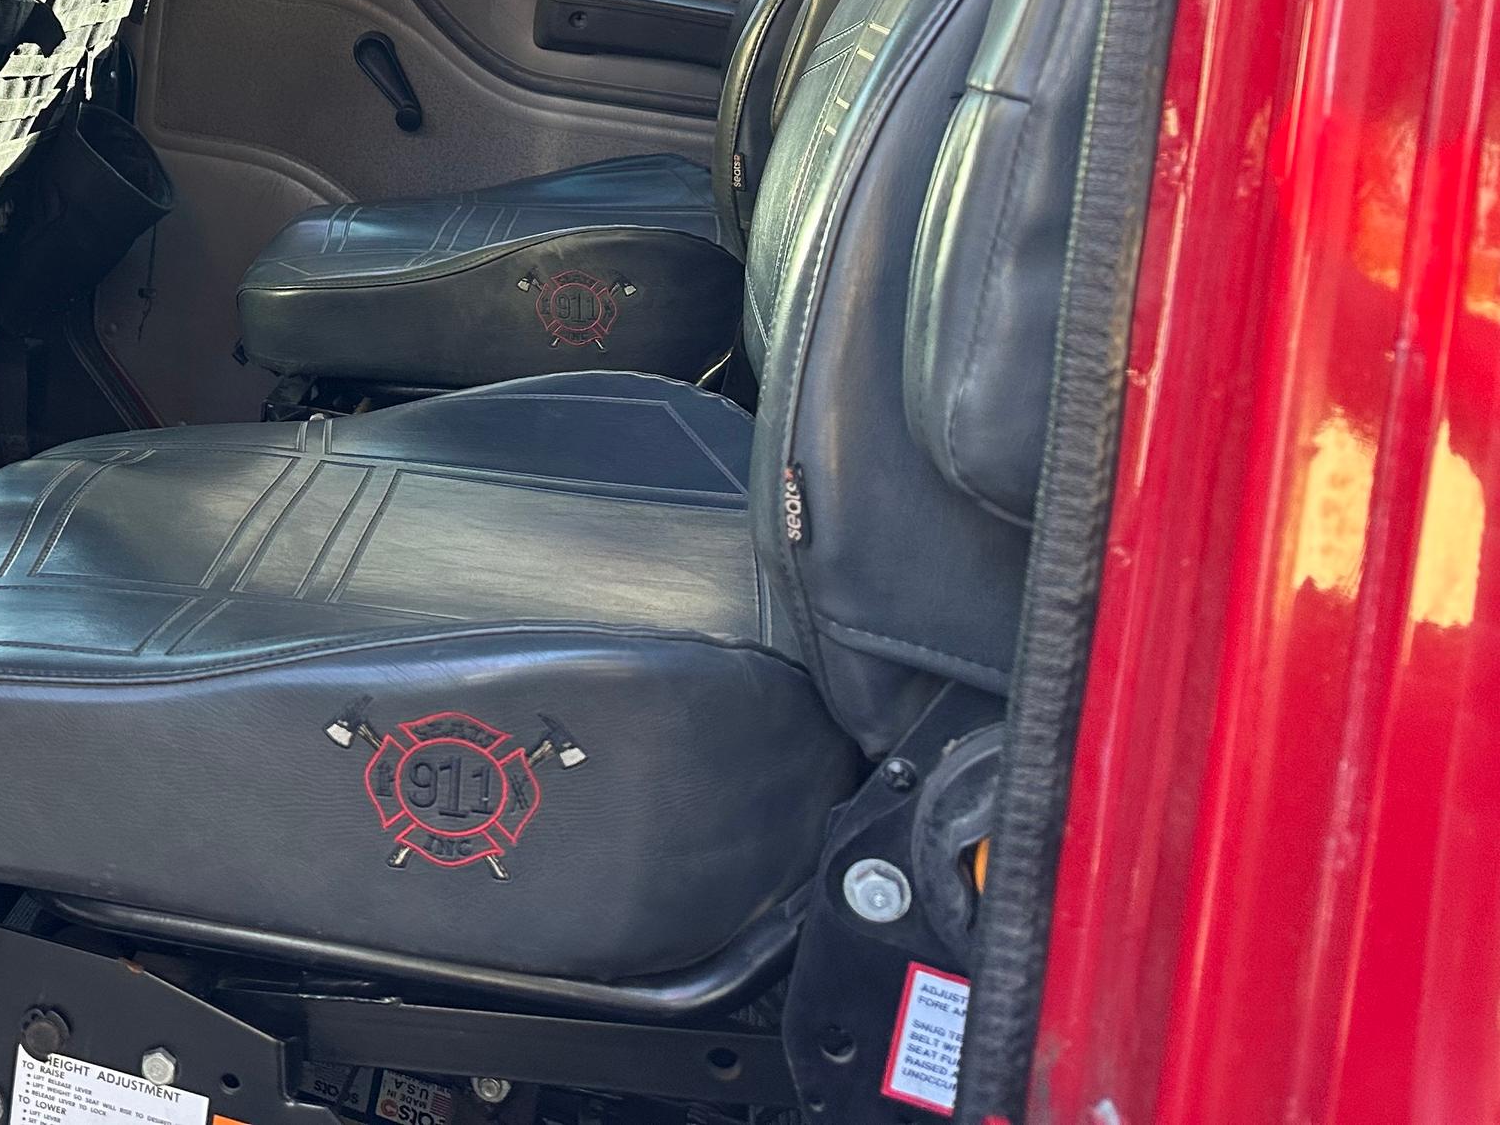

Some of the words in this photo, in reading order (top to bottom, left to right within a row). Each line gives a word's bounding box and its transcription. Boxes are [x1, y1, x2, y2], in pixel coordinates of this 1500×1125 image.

[733, 161, 742, 188] seats
[558, 293, 596, 323] 911
[785, 481, 802, 541] seats
[408, 756, 495, 818] 911
[917, 995, 950, 1013] FORE
[920, 983, 969, 1004] ADJUST
[912, 1018, 946, 1037] SNUG
[910, 1030, 940, 1048] BELT
[906, 1042, 938, 1060] SEAT
[22, 1059, 35, 1070] TO
[39, 1065, 65, 1079] RAISE
[904, 1054, 949, 1076] RAISED
[96, 1071, 181, 1103] ADJUSTMENT
[313, 1079, 360, 1105] sats
[18, 1094, 31, 1105] TO
[35, 1100, 67, 1115] LOWER
